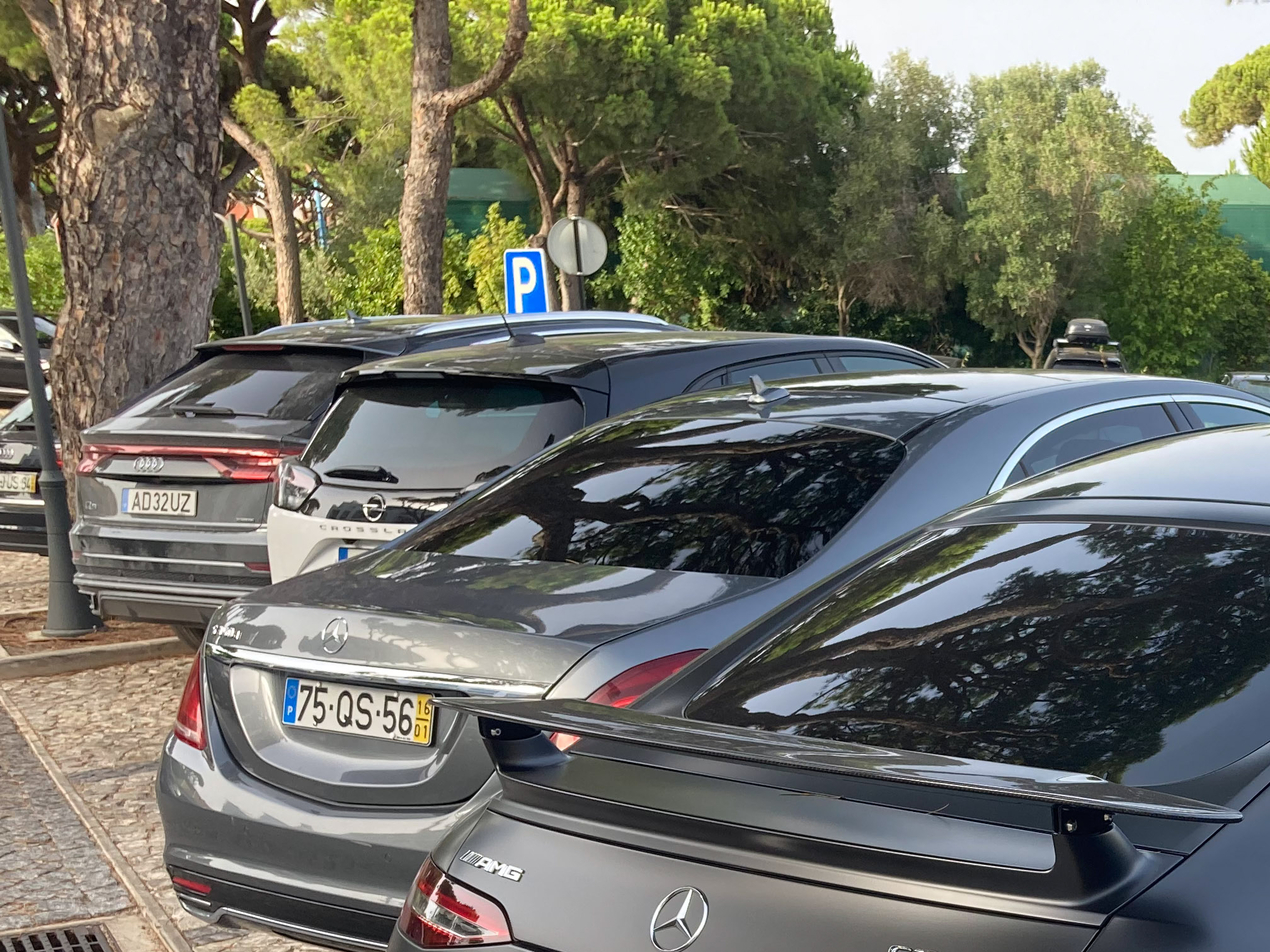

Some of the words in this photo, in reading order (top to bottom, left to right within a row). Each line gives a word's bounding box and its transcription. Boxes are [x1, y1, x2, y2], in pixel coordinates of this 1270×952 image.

[512, 256, 537, 314] P
[131, 491, 191, 513] AD32UZ
[286, 705, 293, 716] P
[418, 701, 430, 716] 16
[414, 724, 428, 739] 01
